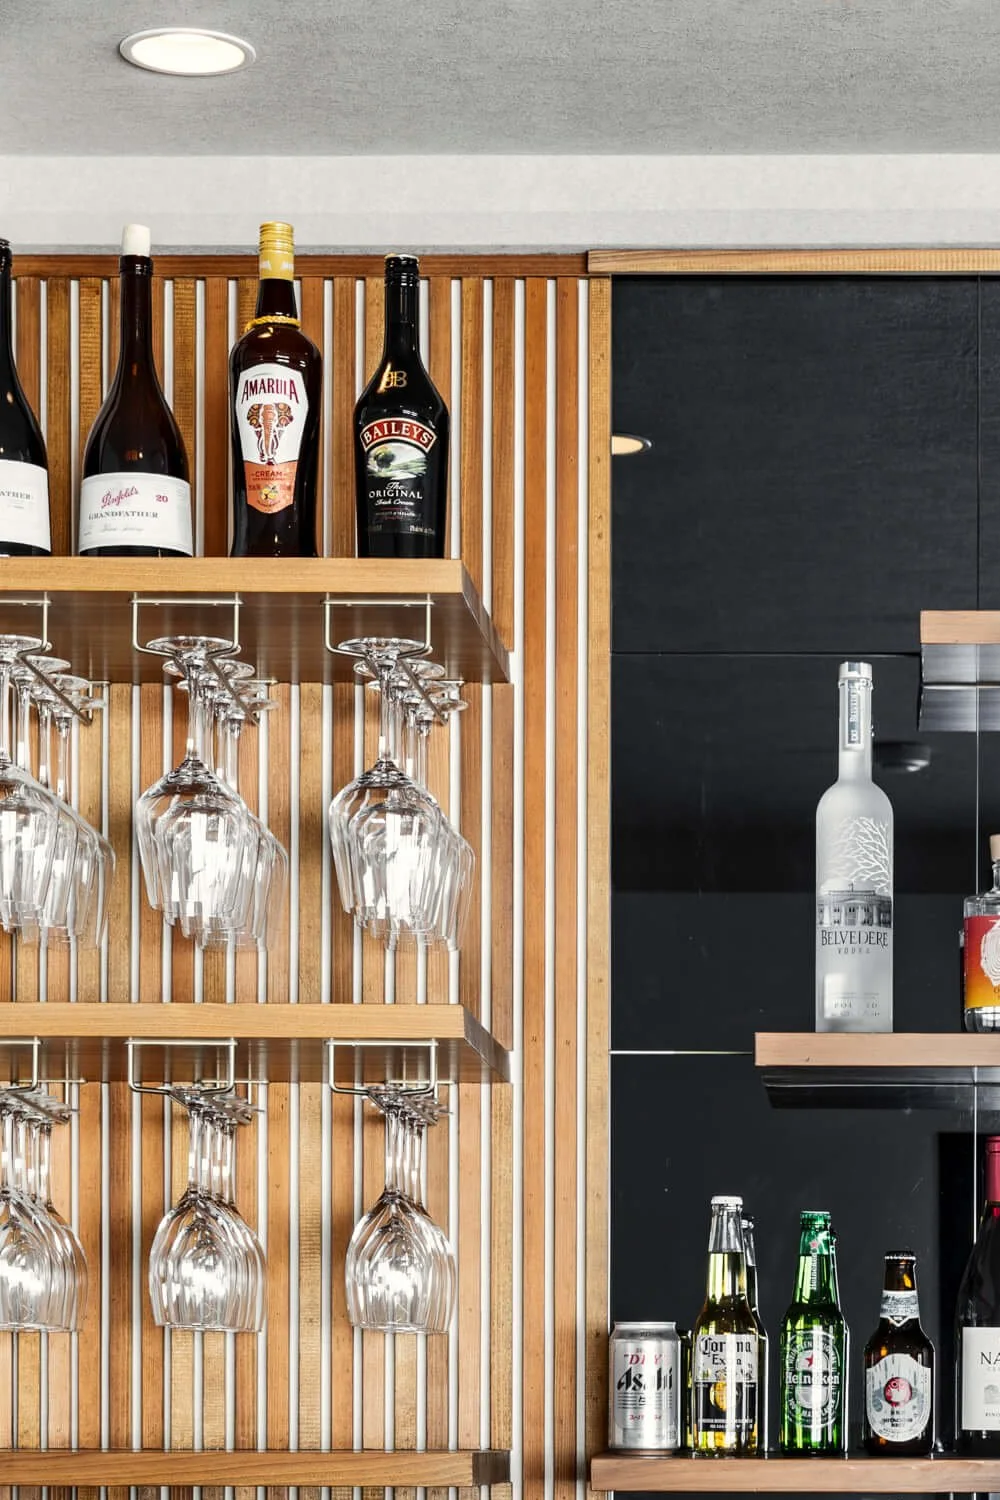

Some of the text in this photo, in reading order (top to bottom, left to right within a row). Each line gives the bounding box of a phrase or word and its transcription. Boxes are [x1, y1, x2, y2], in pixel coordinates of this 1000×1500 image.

[240, 378, 300, 405] AMARULA
[362, 421, 433, 445] BAILEYS
[254, 470, 283, 478] CREAM
[385, 481, 407, 491] The
[155, 494, 169, 503] 20
[368, 489, 423, 500] ORIGINAL
[88, 510, 159, 521] GRANDFATHER
[821, 929, 889, 949] BELVEDERE
[701, 1337, 753, 1357] Corna
